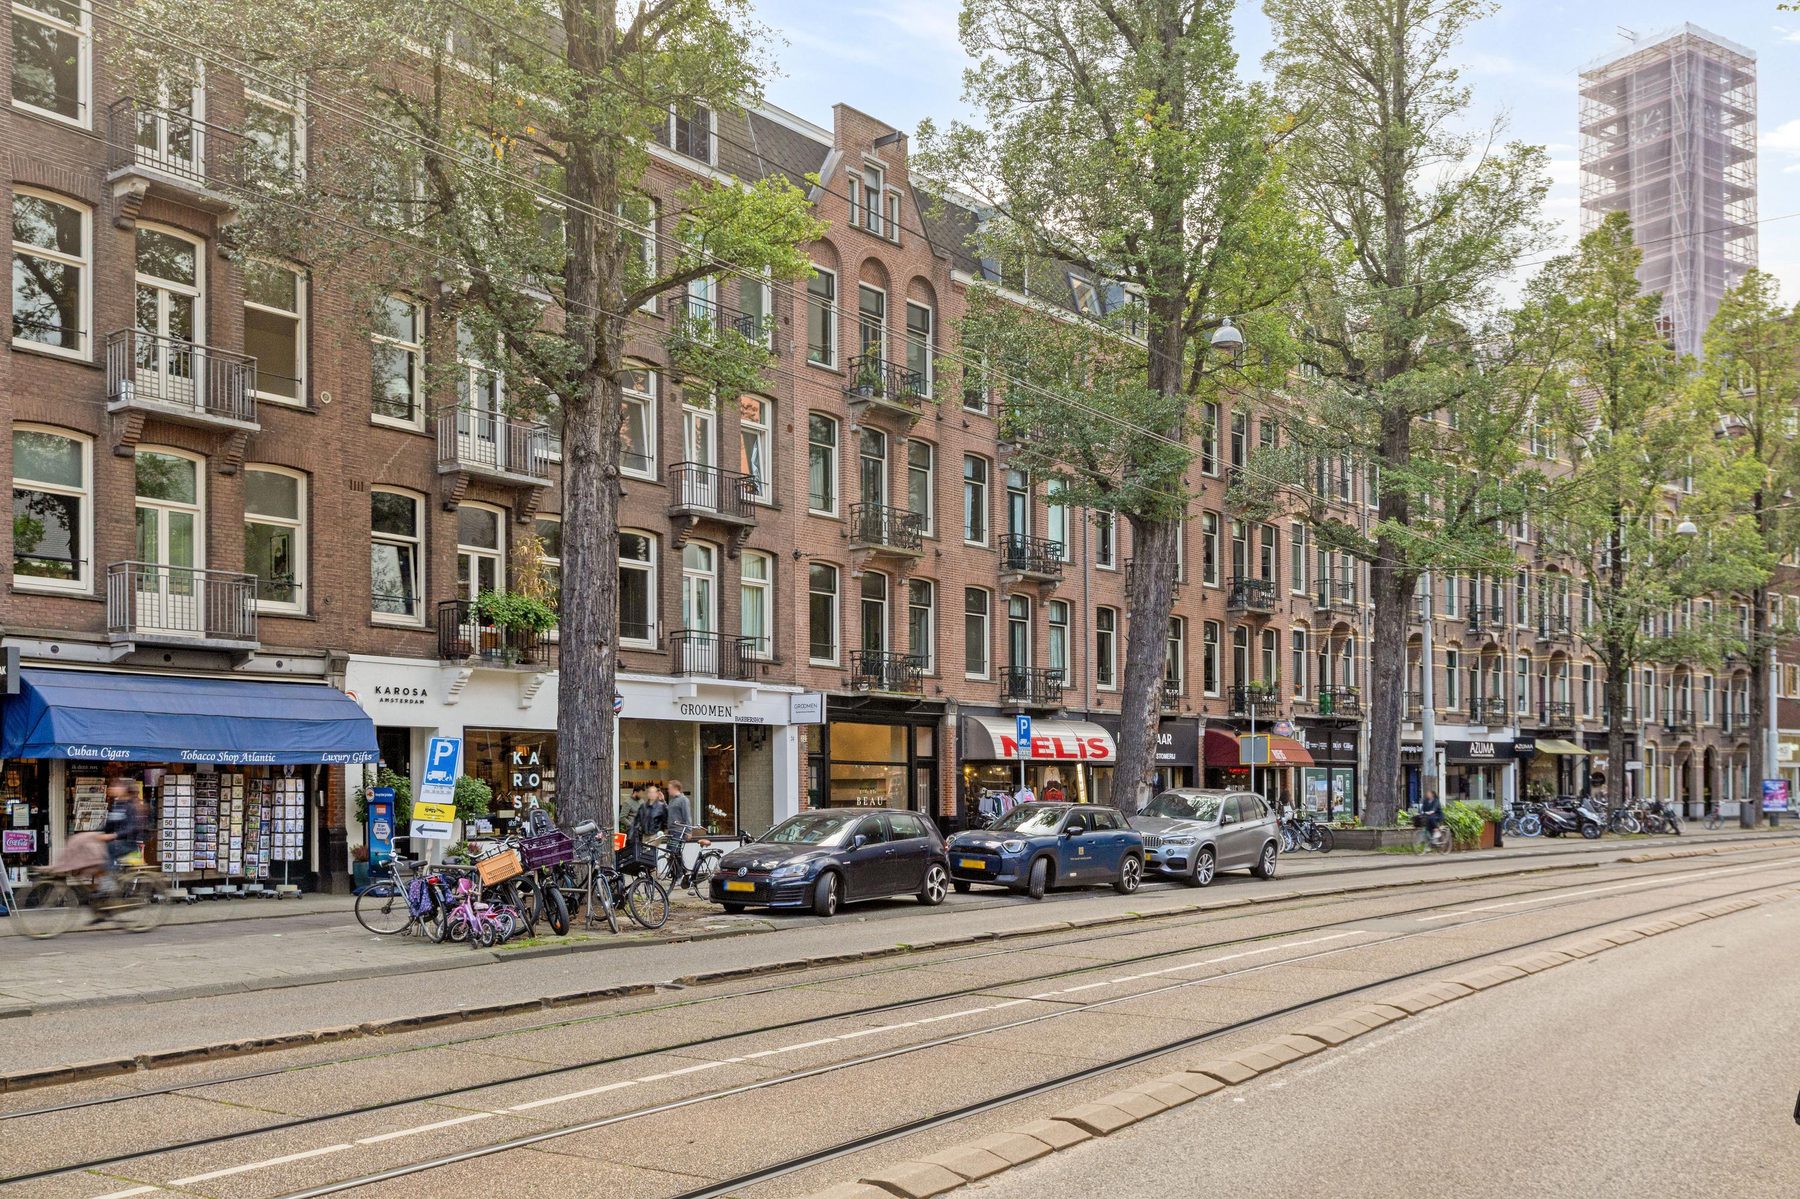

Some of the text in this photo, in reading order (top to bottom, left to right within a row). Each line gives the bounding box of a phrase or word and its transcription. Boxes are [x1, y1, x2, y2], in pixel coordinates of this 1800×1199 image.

[375, 686, 428, 696] KAROSA
[680, 703, 733, 718] GROOMEN
[1020, 719, 1028, 735] P
[1157, 733, 1172, 745] AAR
[67, 745, 130, 760] Cuban Cigars
[433, 741, 453, 765] P
[1470, 741, 1495, 754] AZUMA
[181, 750, 276, 764] Tobacco Shop Atlantic
[321, 751, 373, 763] Luxury Gifts
[856, 796, 883, 806] BEAU
